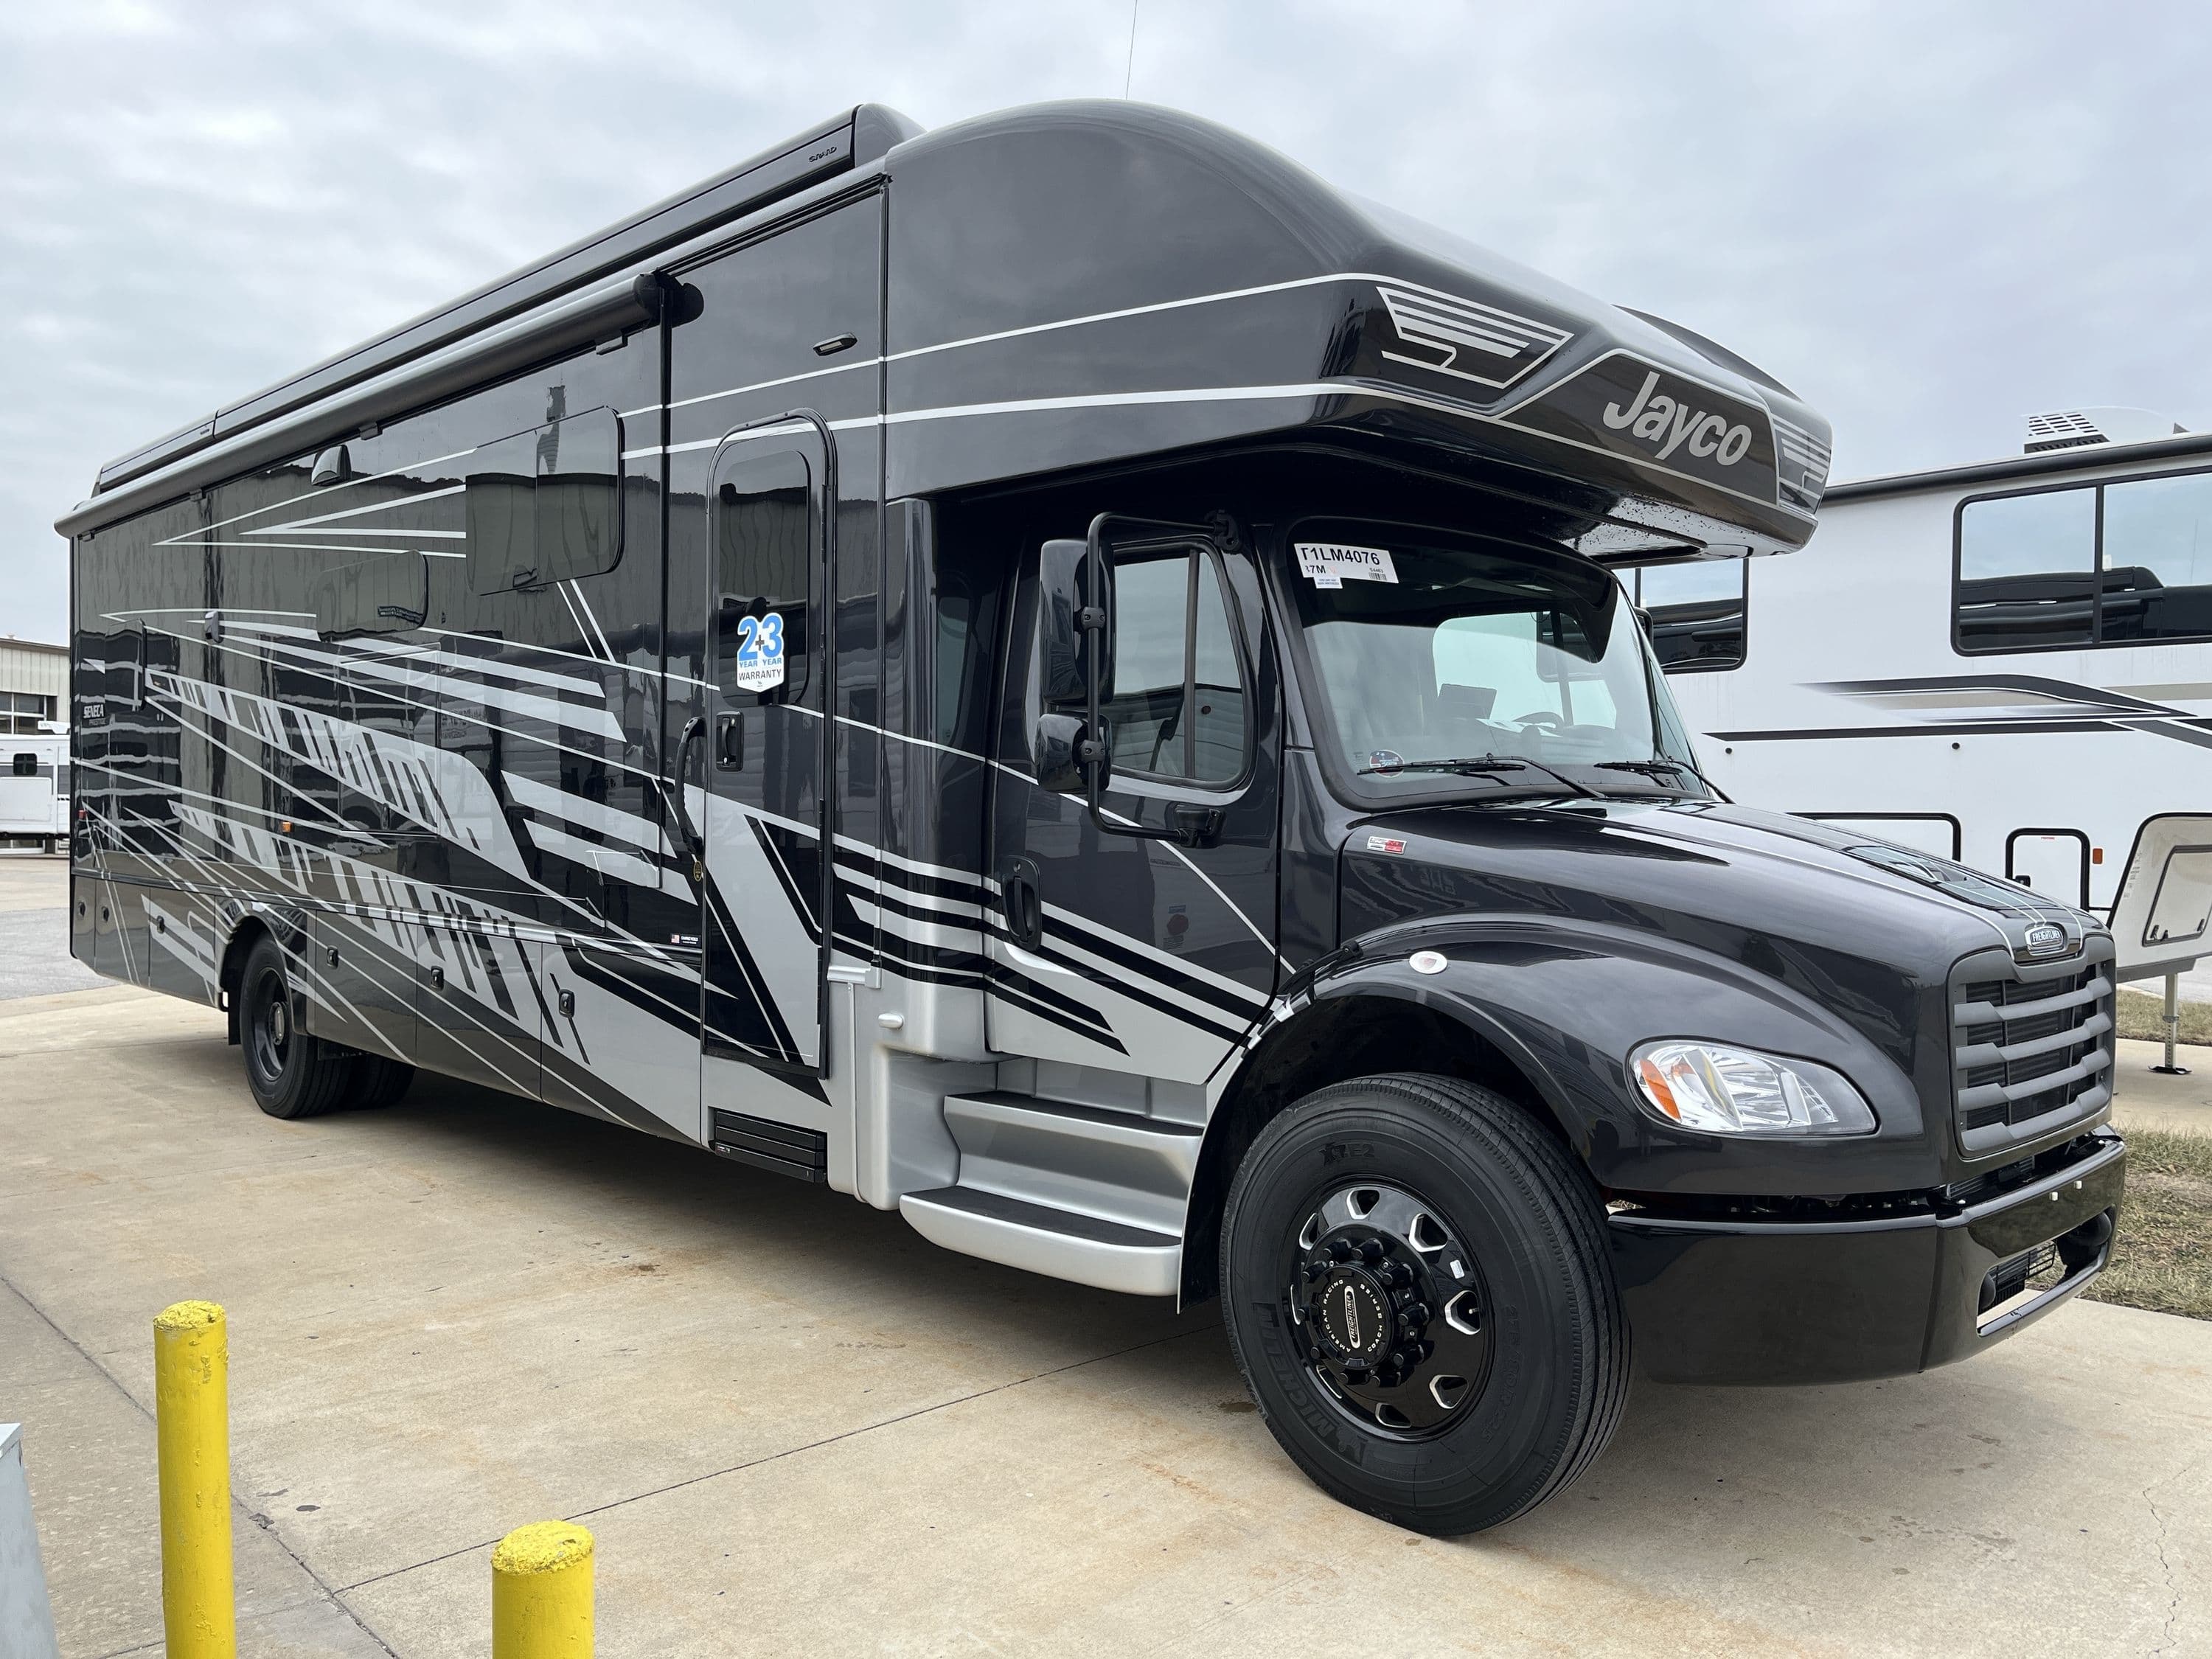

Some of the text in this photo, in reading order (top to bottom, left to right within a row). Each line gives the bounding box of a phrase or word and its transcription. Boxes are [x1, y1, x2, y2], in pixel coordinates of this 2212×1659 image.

[1602, 370, 1753, 466] Jayco
[739, 658, 782, 668] YEAR YEAR
[739, 669, 782, 681] WARRANTY
[83, 703, 104, 719] SENECA
[1323, 1279, 1351, 1352] AMERICAN RACING
[1360, 1284, 1382, 1352] COACH SERIES
